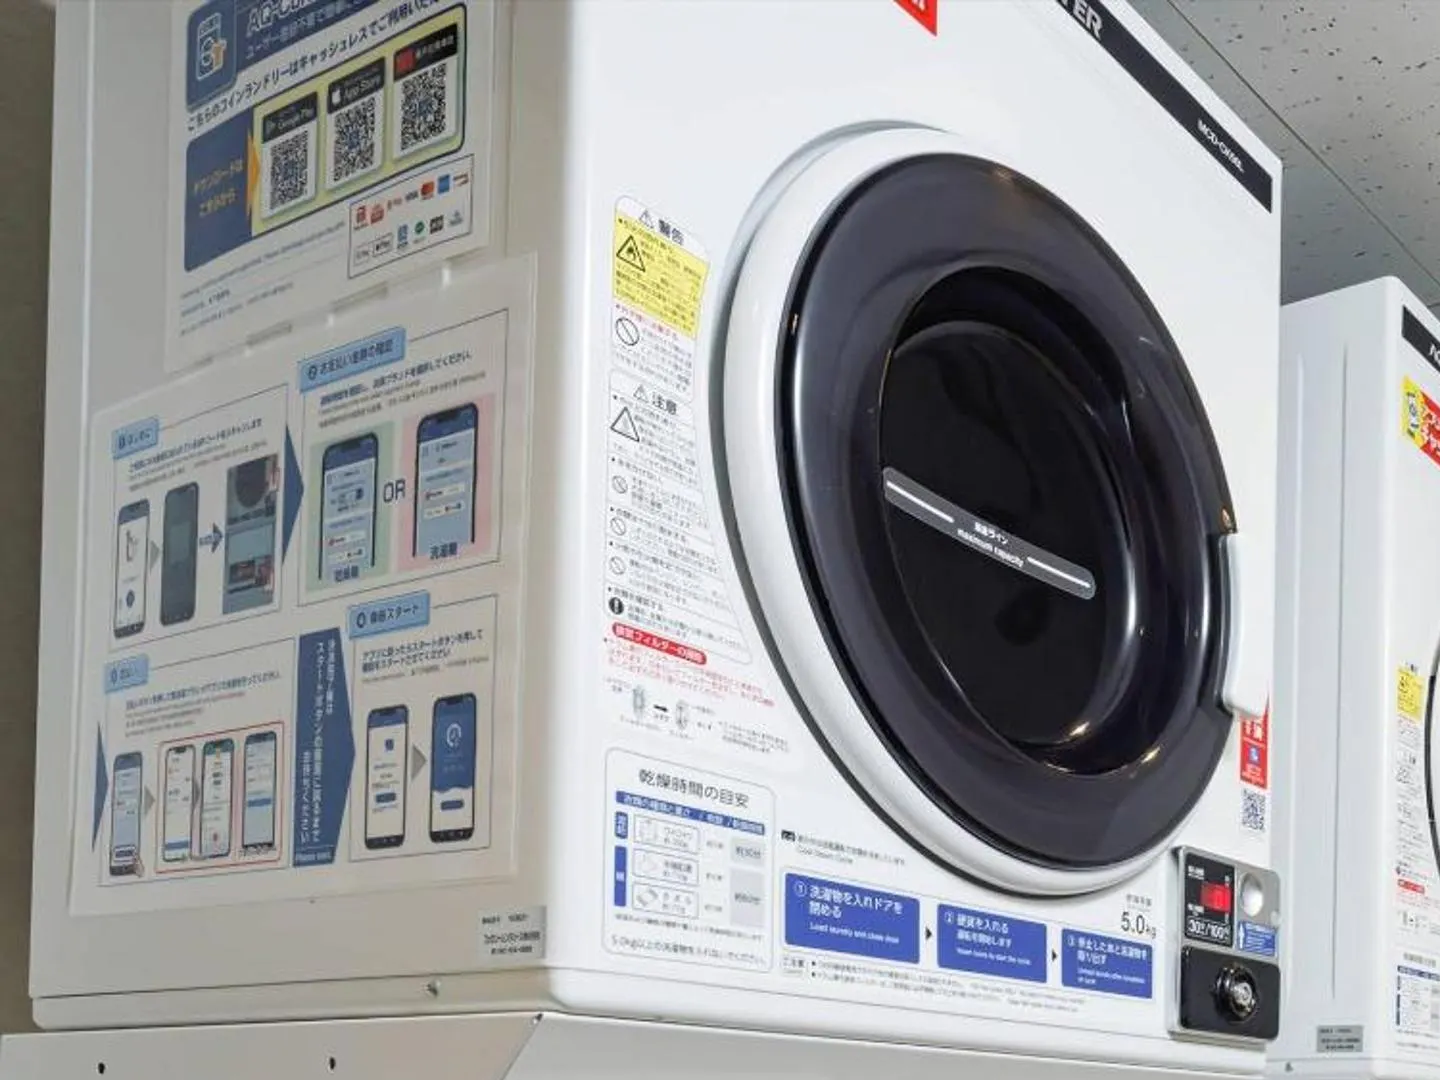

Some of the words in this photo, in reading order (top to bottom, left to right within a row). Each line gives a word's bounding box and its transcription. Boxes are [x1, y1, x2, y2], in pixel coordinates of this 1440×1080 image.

[651, 392, 678, 416] 注意
[383, 480, 406, 503] OR
[638, 768, 750, 809] 乾燥時間の目安
[809, 900, 843, 919] 閉める
